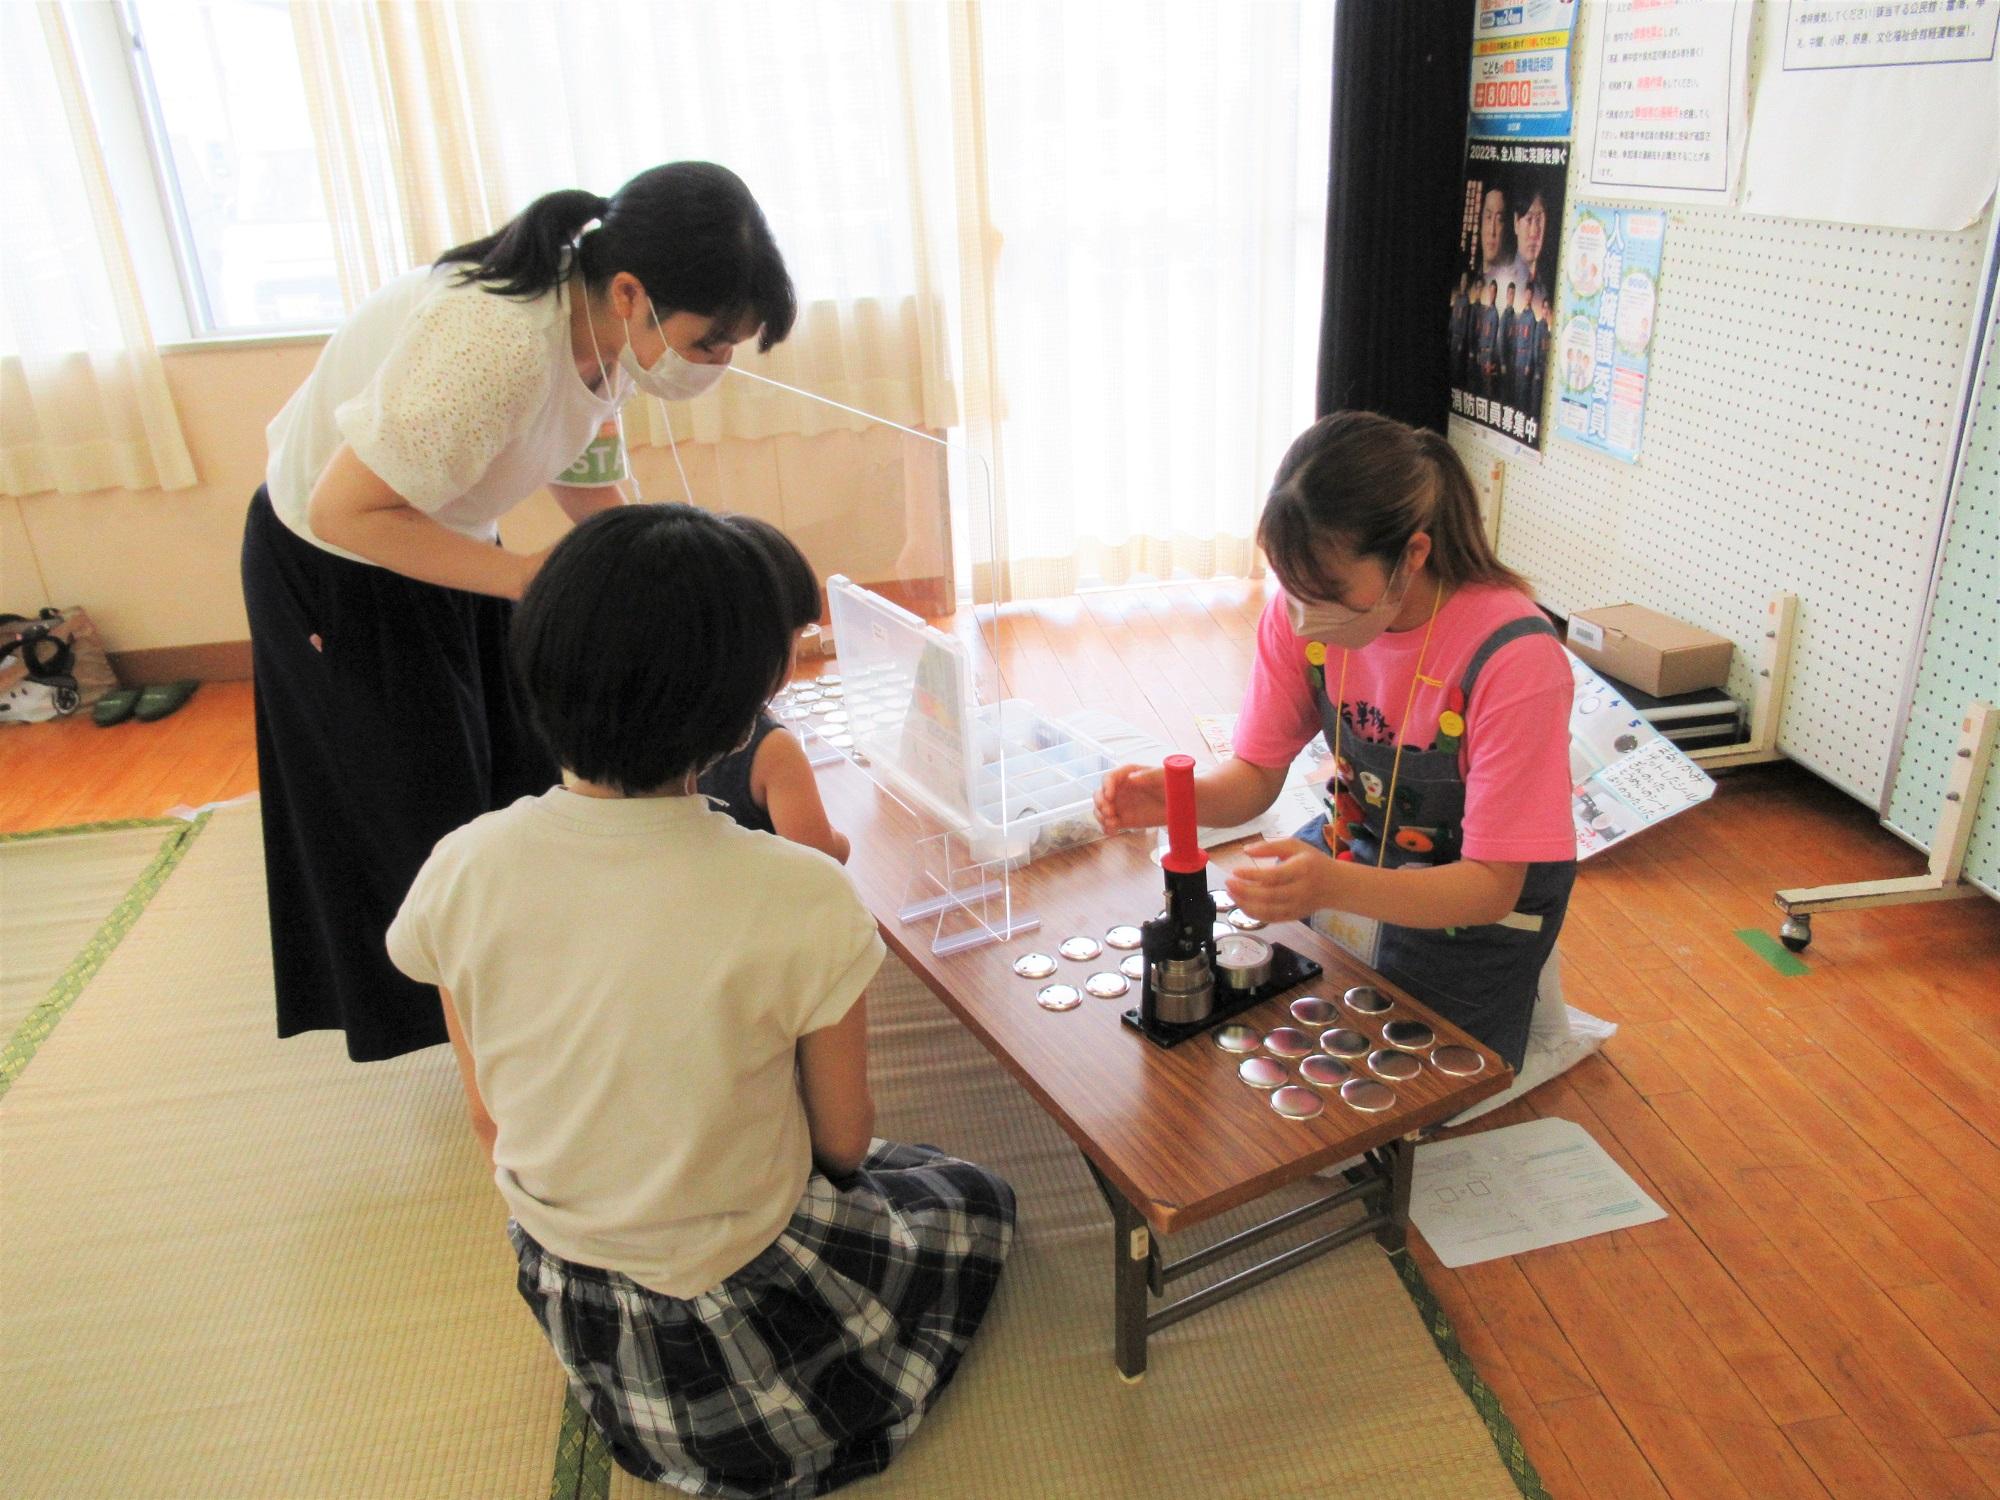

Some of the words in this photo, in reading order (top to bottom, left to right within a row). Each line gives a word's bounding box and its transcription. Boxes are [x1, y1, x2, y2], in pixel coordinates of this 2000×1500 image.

[1588, 210, 1625, 439] 人権擁護委員
[1451, 387, 1537, 443] 消防団員募集中
[1628, 719, 1642, 728] 5
